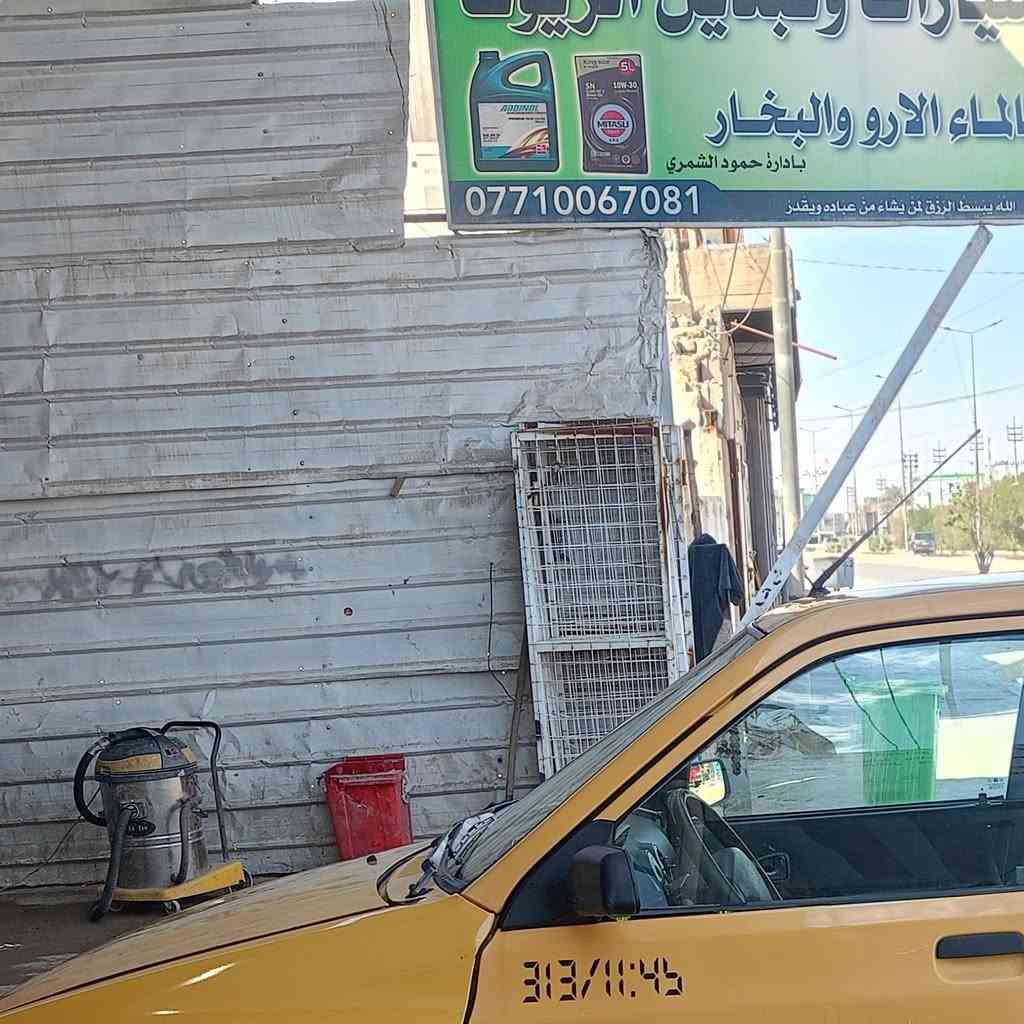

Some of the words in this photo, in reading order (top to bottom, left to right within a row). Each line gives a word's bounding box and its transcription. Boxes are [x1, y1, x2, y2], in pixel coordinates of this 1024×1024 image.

[705, 89, 852, 148] والبخار
[665, 153, 718, 174] الشمري
[720, 158, 763, 173] حمود
[464, 185, 700, 216] 07710067081
[823, 200, 857, 215] عباده
[859, 200, 876, 215] من
[878, 199, 905, 215] يشاء
[925, 199, 956, 215] الرزق
[957, 198, 993, 215] يبسط
[996, 199, 1016, 212] الله
[523, 957, 683, 1004] 313/11:45
